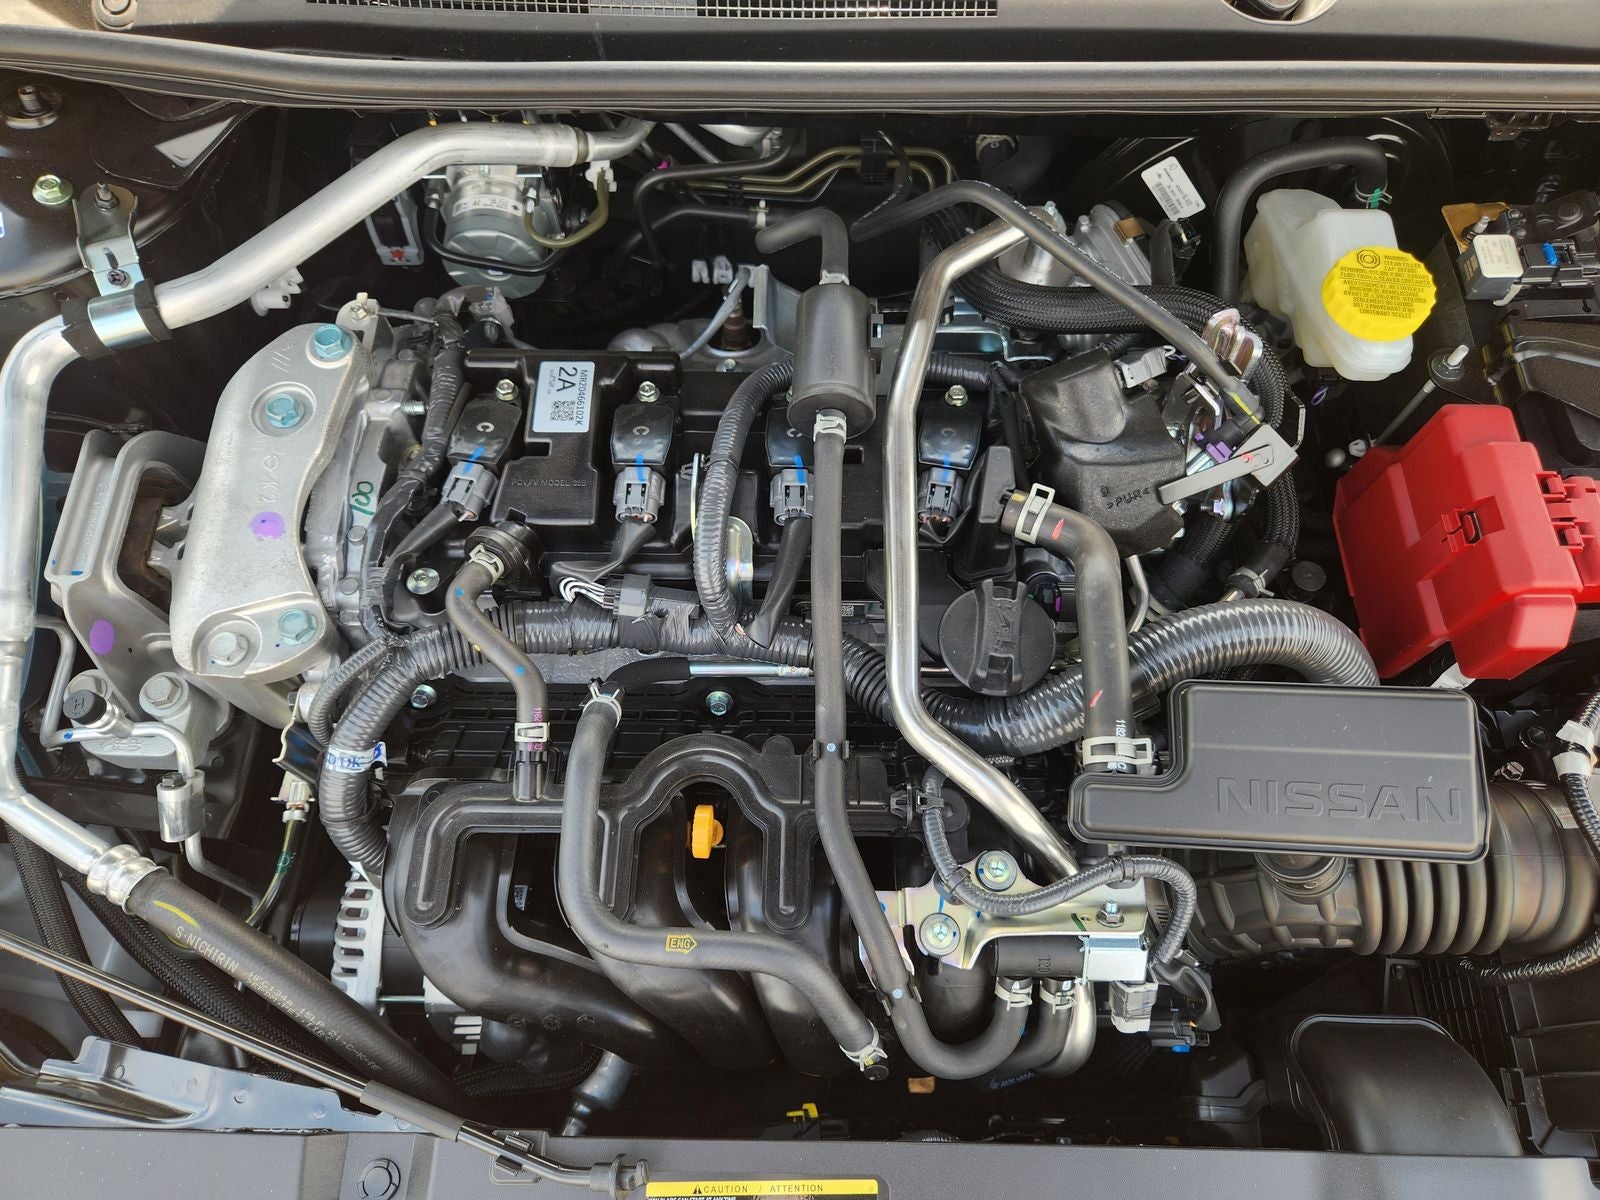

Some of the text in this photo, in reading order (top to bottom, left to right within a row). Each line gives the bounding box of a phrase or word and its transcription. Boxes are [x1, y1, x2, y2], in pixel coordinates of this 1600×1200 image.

[556, 366, 578, 393] 2A
[1217, 776, 1462, 825] NISSAN
[670, 937, 691, 950] ENG
[703, 1185, 749, 1194] CAUTION
[769, 1184, 824, 1193] ATTENTION
